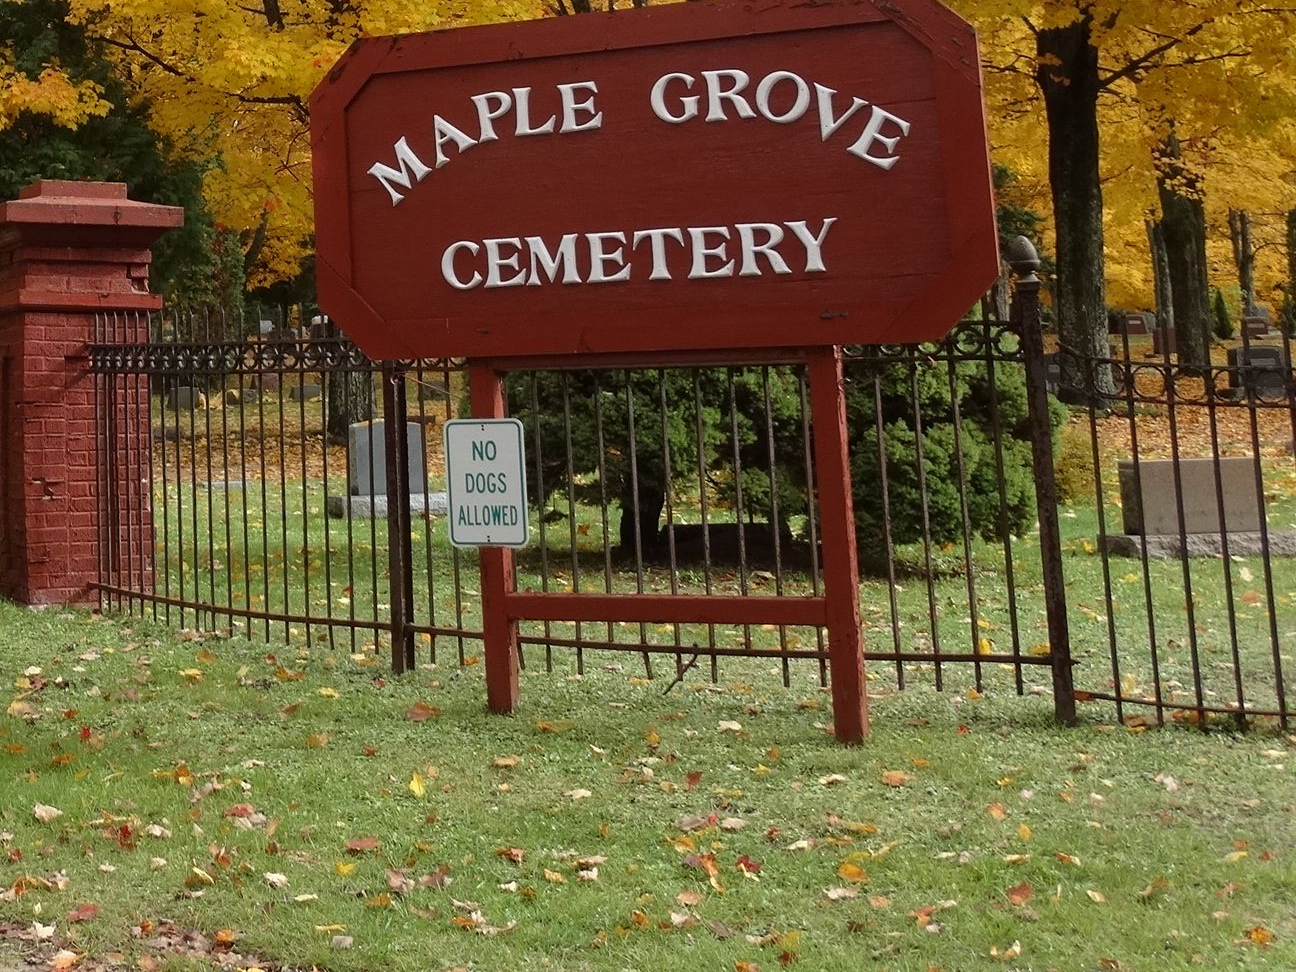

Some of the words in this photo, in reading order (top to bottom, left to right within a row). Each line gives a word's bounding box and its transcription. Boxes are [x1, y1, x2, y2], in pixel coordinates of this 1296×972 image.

[368, 81, 602, 206] MAPLE
[650, 69, 910, 170] GROVE
[440, 217, 836, 290] CEMETERY
[472, 440, 497, 461] NO
[465, 473, 507, 493] DOGS
[458, 505, 518, 526] ALLOWED
